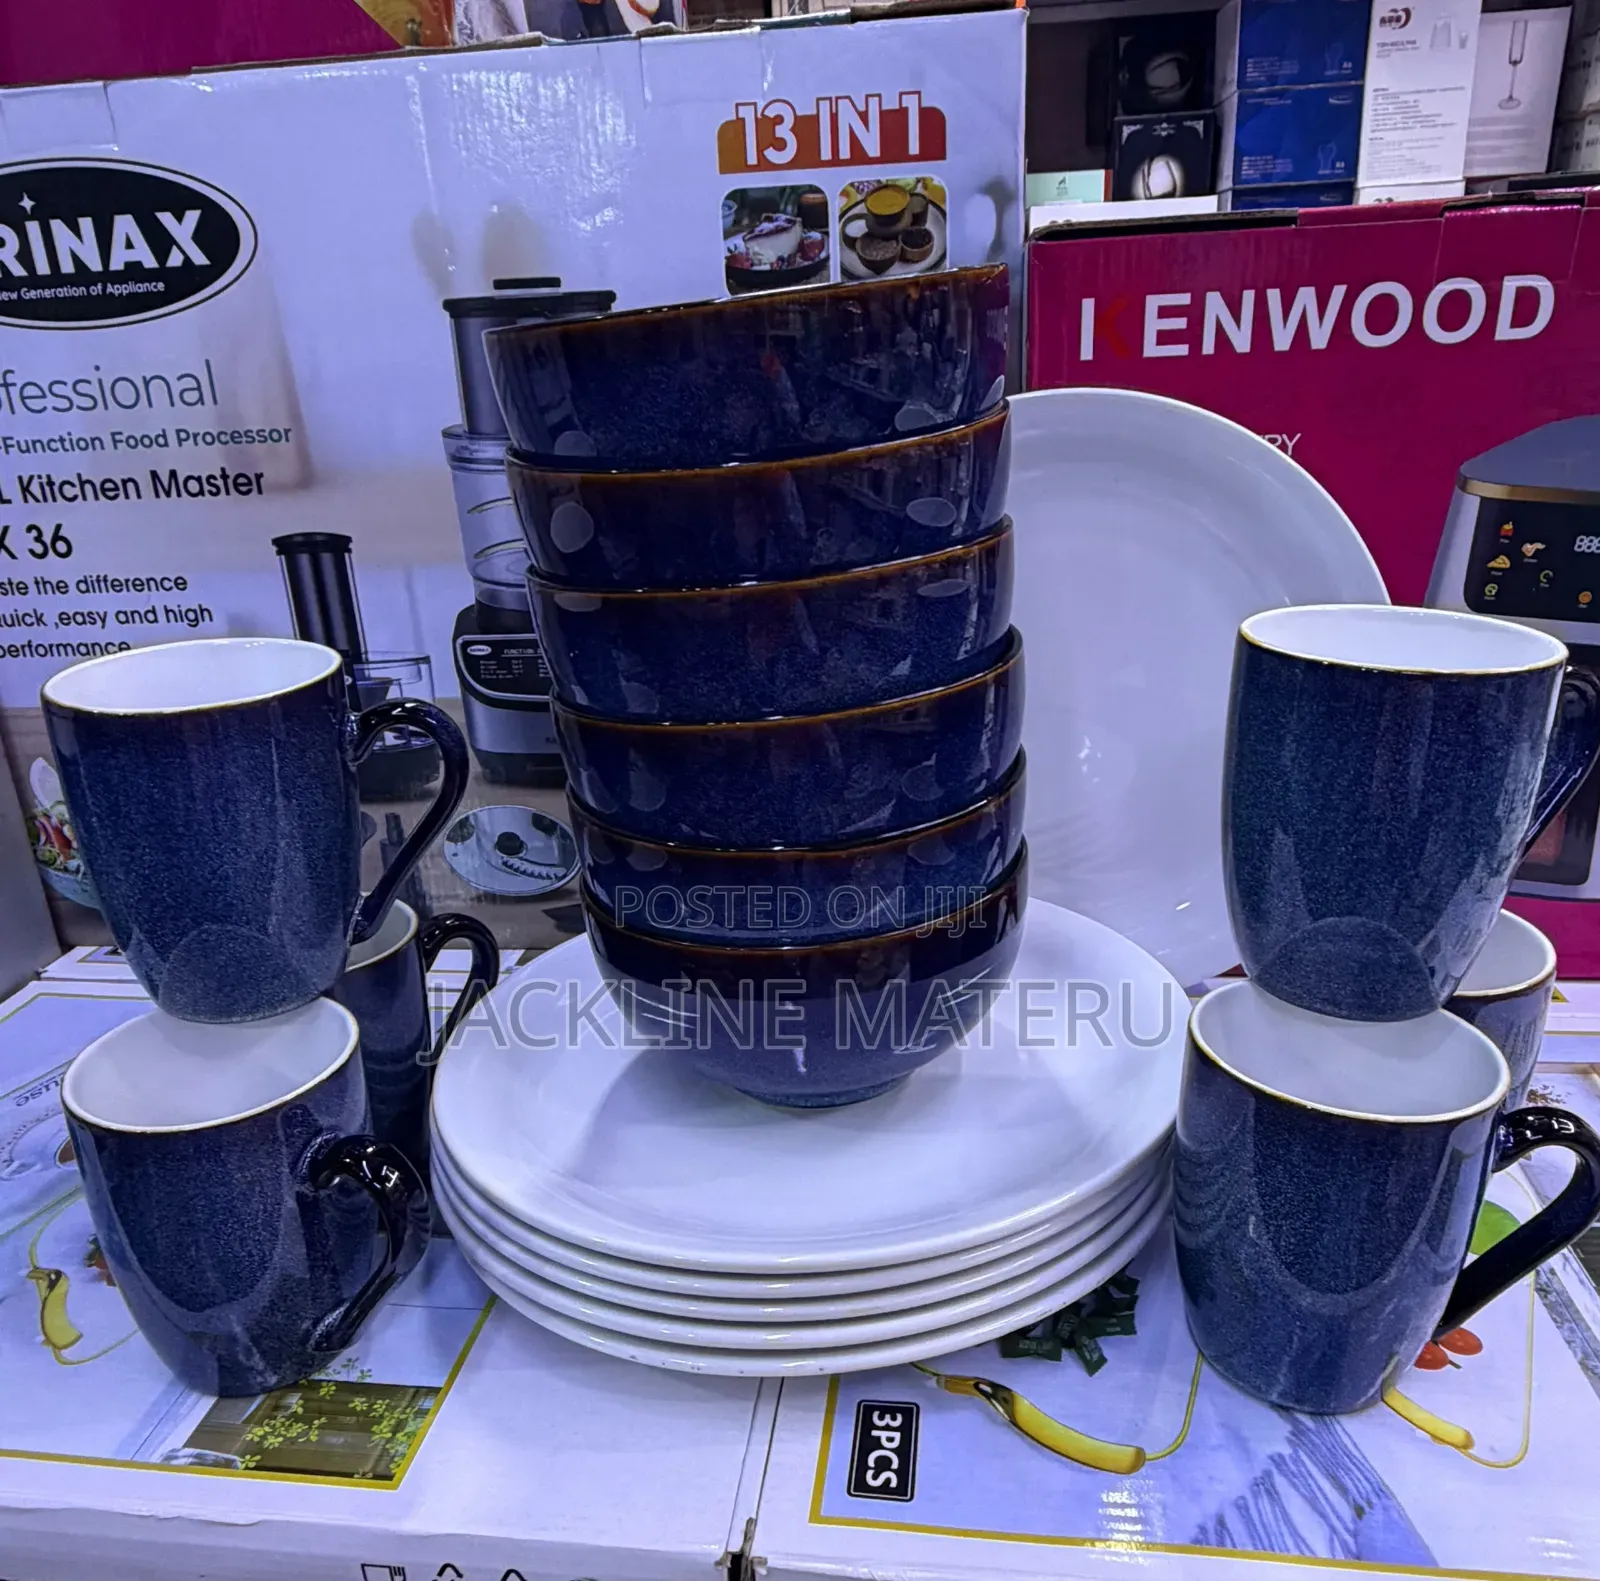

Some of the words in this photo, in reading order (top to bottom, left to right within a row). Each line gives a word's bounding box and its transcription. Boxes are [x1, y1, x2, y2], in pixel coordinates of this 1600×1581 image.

[735, 98, 797, 165] 13
[816, 93, 882, 161] IN
[899, 90, 922, 156] 1
[0, 289, 18, 301] ew
[20, 284, 87, 300] Generation
[89, 282, 103, 295] of
[106, 281, 165, 298] Appliance
[0, 359, 219, 415] fessional
[110, 428, 170, 451] Food
[176, 425, 292, 449] Processor
[17, 472, 142, 504] Kitchen
[150, 467, 264, 499] Master
[25, 523, 73, 560] 36
[33, 576, 70, 596] the
[75, 573, 188, 595] difference
[0, 608, 49, 628] uick
[115, 605, 157, 626] and
[163, 602, 214, 628] high
[865, 1410, 903, 1488] 3PCS
